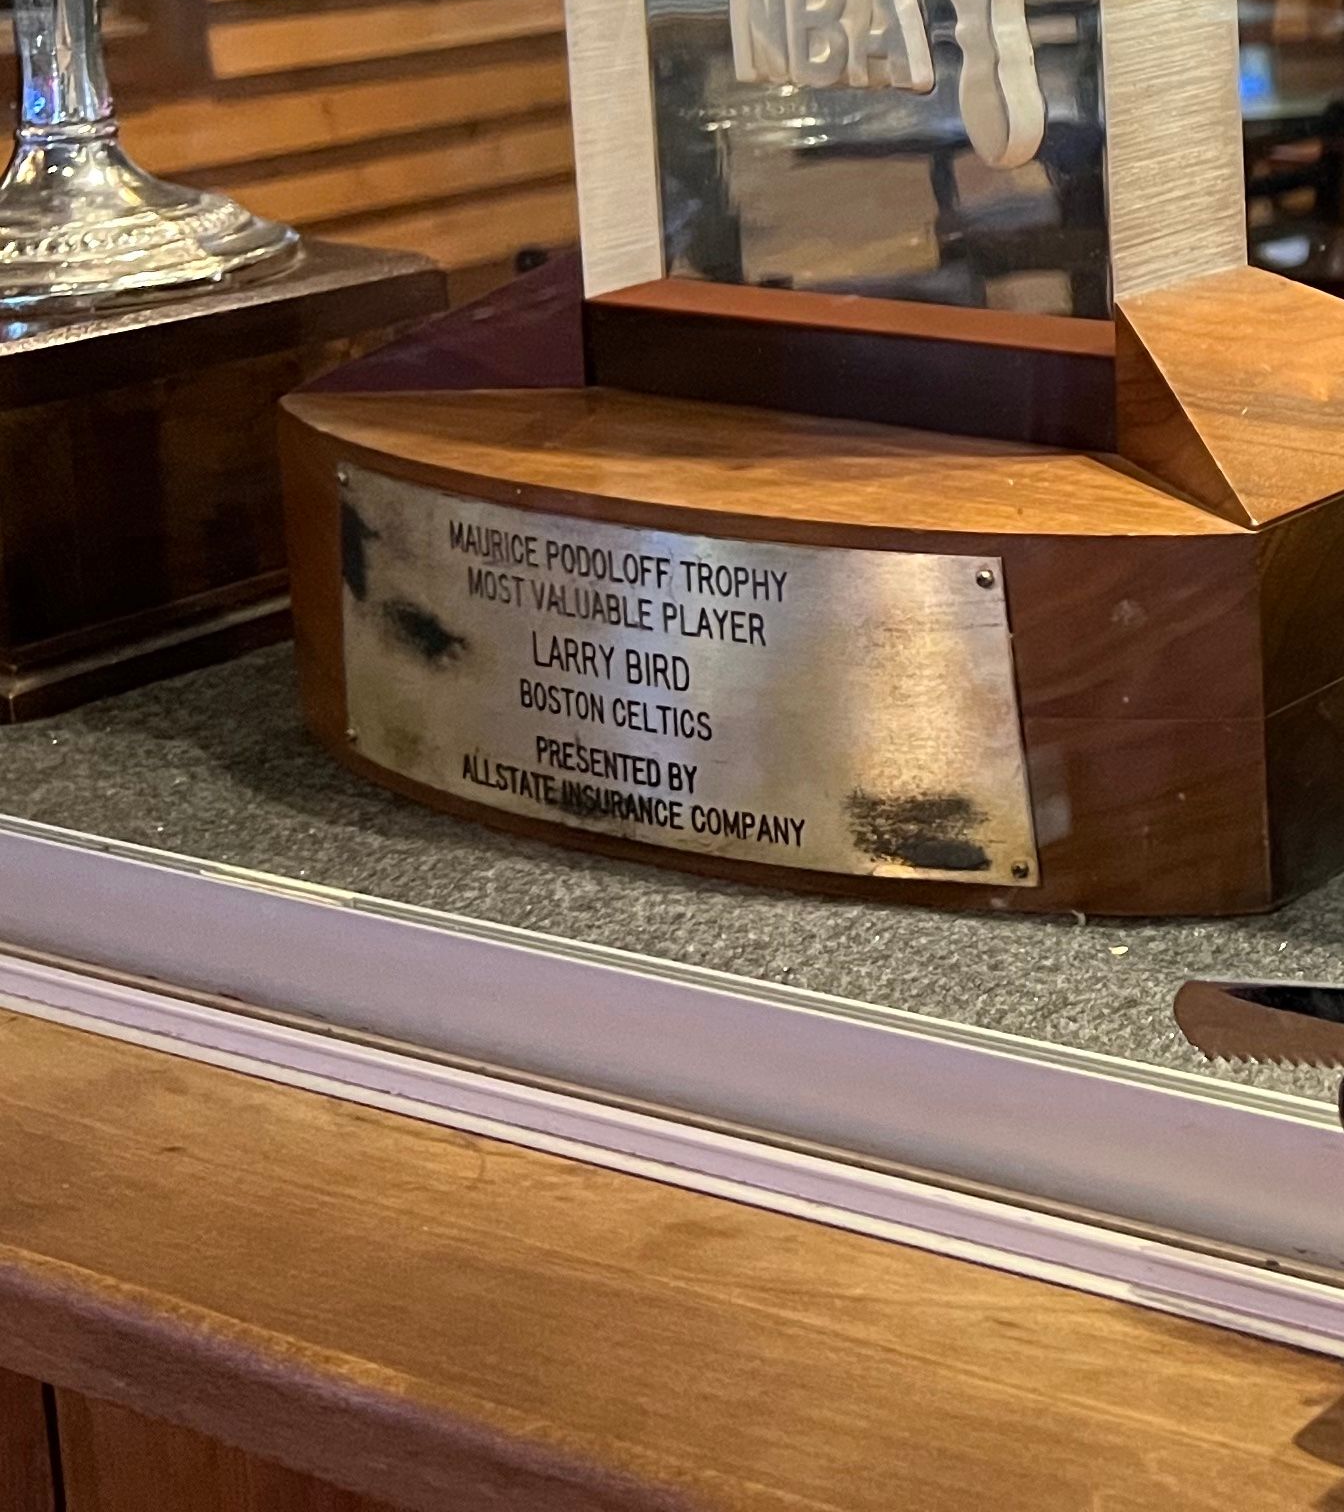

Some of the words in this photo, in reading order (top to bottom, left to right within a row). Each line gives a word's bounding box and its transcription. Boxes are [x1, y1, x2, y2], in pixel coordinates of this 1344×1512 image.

[448, 518, 539, 571] MAURICE
[547, 542, 671, 591] PODOLOFF
[679, 559, 788, 604] TROPHY
[466, 566, 528, 606] MOST
[530, 577, 654, 632] VALUABLE
[662, 600, 768, 648] PLAYER
[531, 630, 615, 682] LARRY
[626, 651, 691, 693] BIRD
[519, 678, 606, 727] BOSTON
[611, 697, 714, 743] CELTICS
[461, 751, 559, 807] ALLSTATE
[560, 779, 684, 832] INSURANCE
[690, 802, 806, 849] COMPANY
[535, 735, 662, 789] PRESENTED
[667, 763, 699, 794] BY
